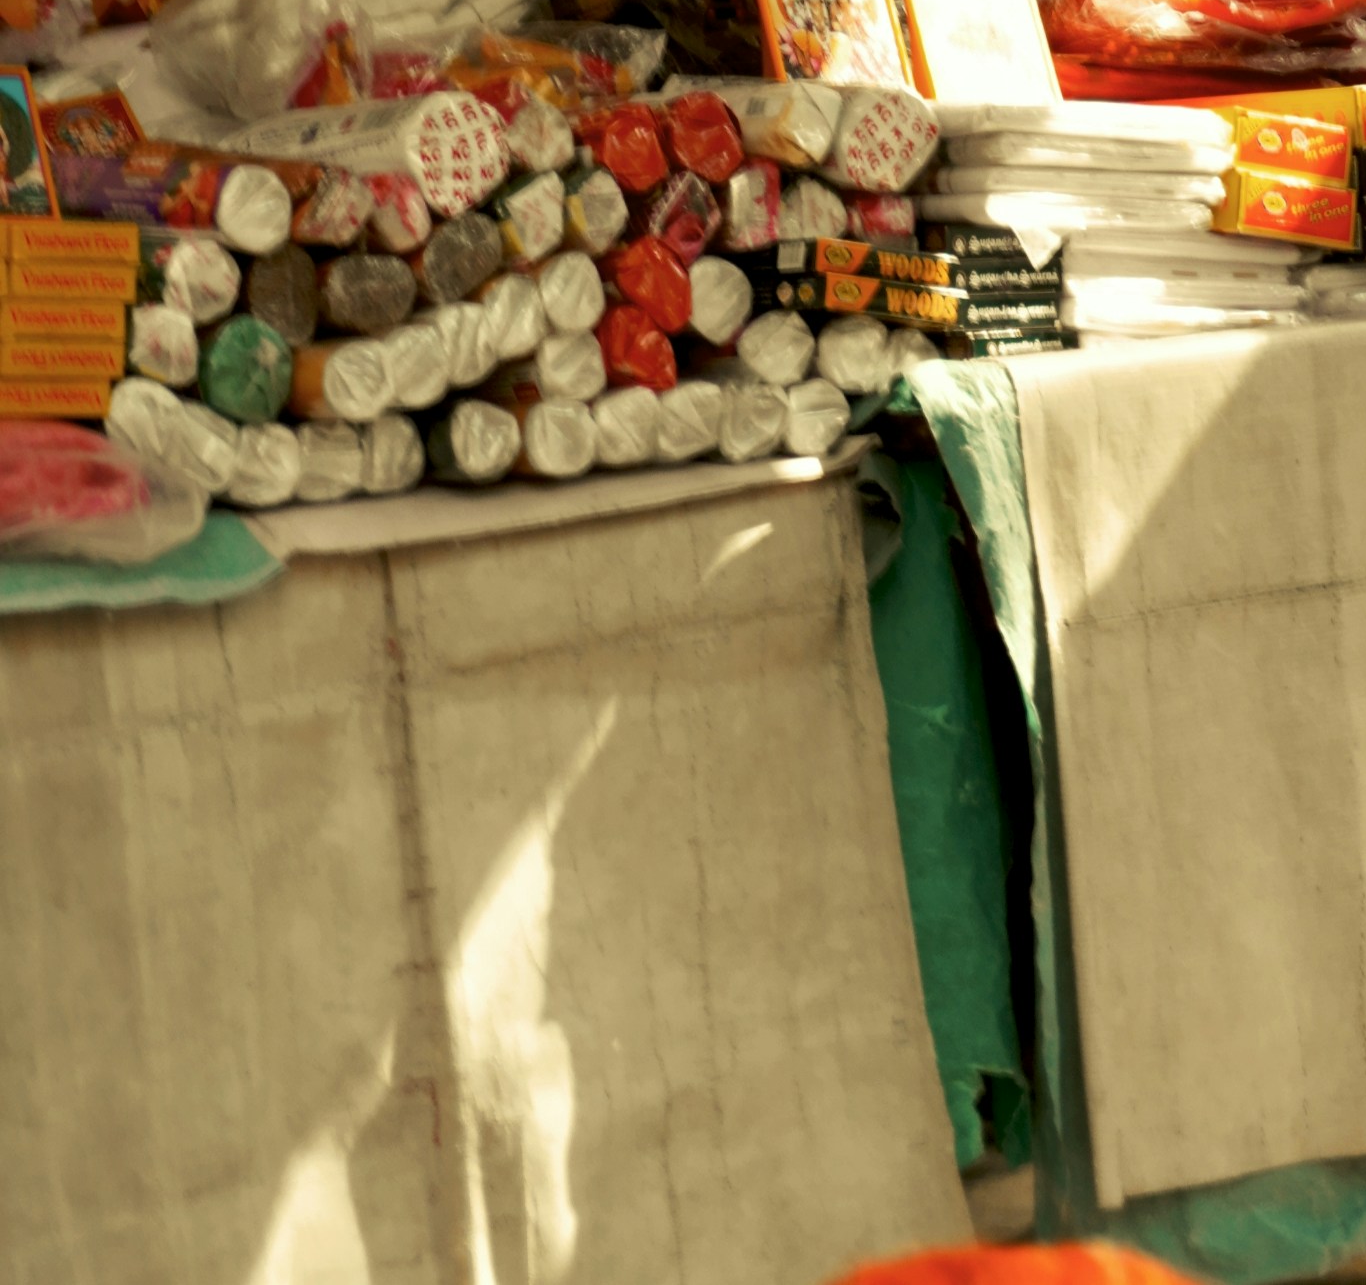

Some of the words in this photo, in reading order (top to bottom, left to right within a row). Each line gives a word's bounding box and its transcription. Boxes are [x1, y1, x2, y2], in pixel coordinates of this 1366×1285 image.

[1286, 134, 1325, 156] tee
[1304, 148, 1319, 161] in
[1319, 142, 1345, 156] one
[1290, 197, 1329, 217] three
[1309, 211, 1322, 224] in
[1323, 204, 1350, 218] one
[877, 249, 950, 286] WOODS
[886, 287, 959, 324] WOODS
